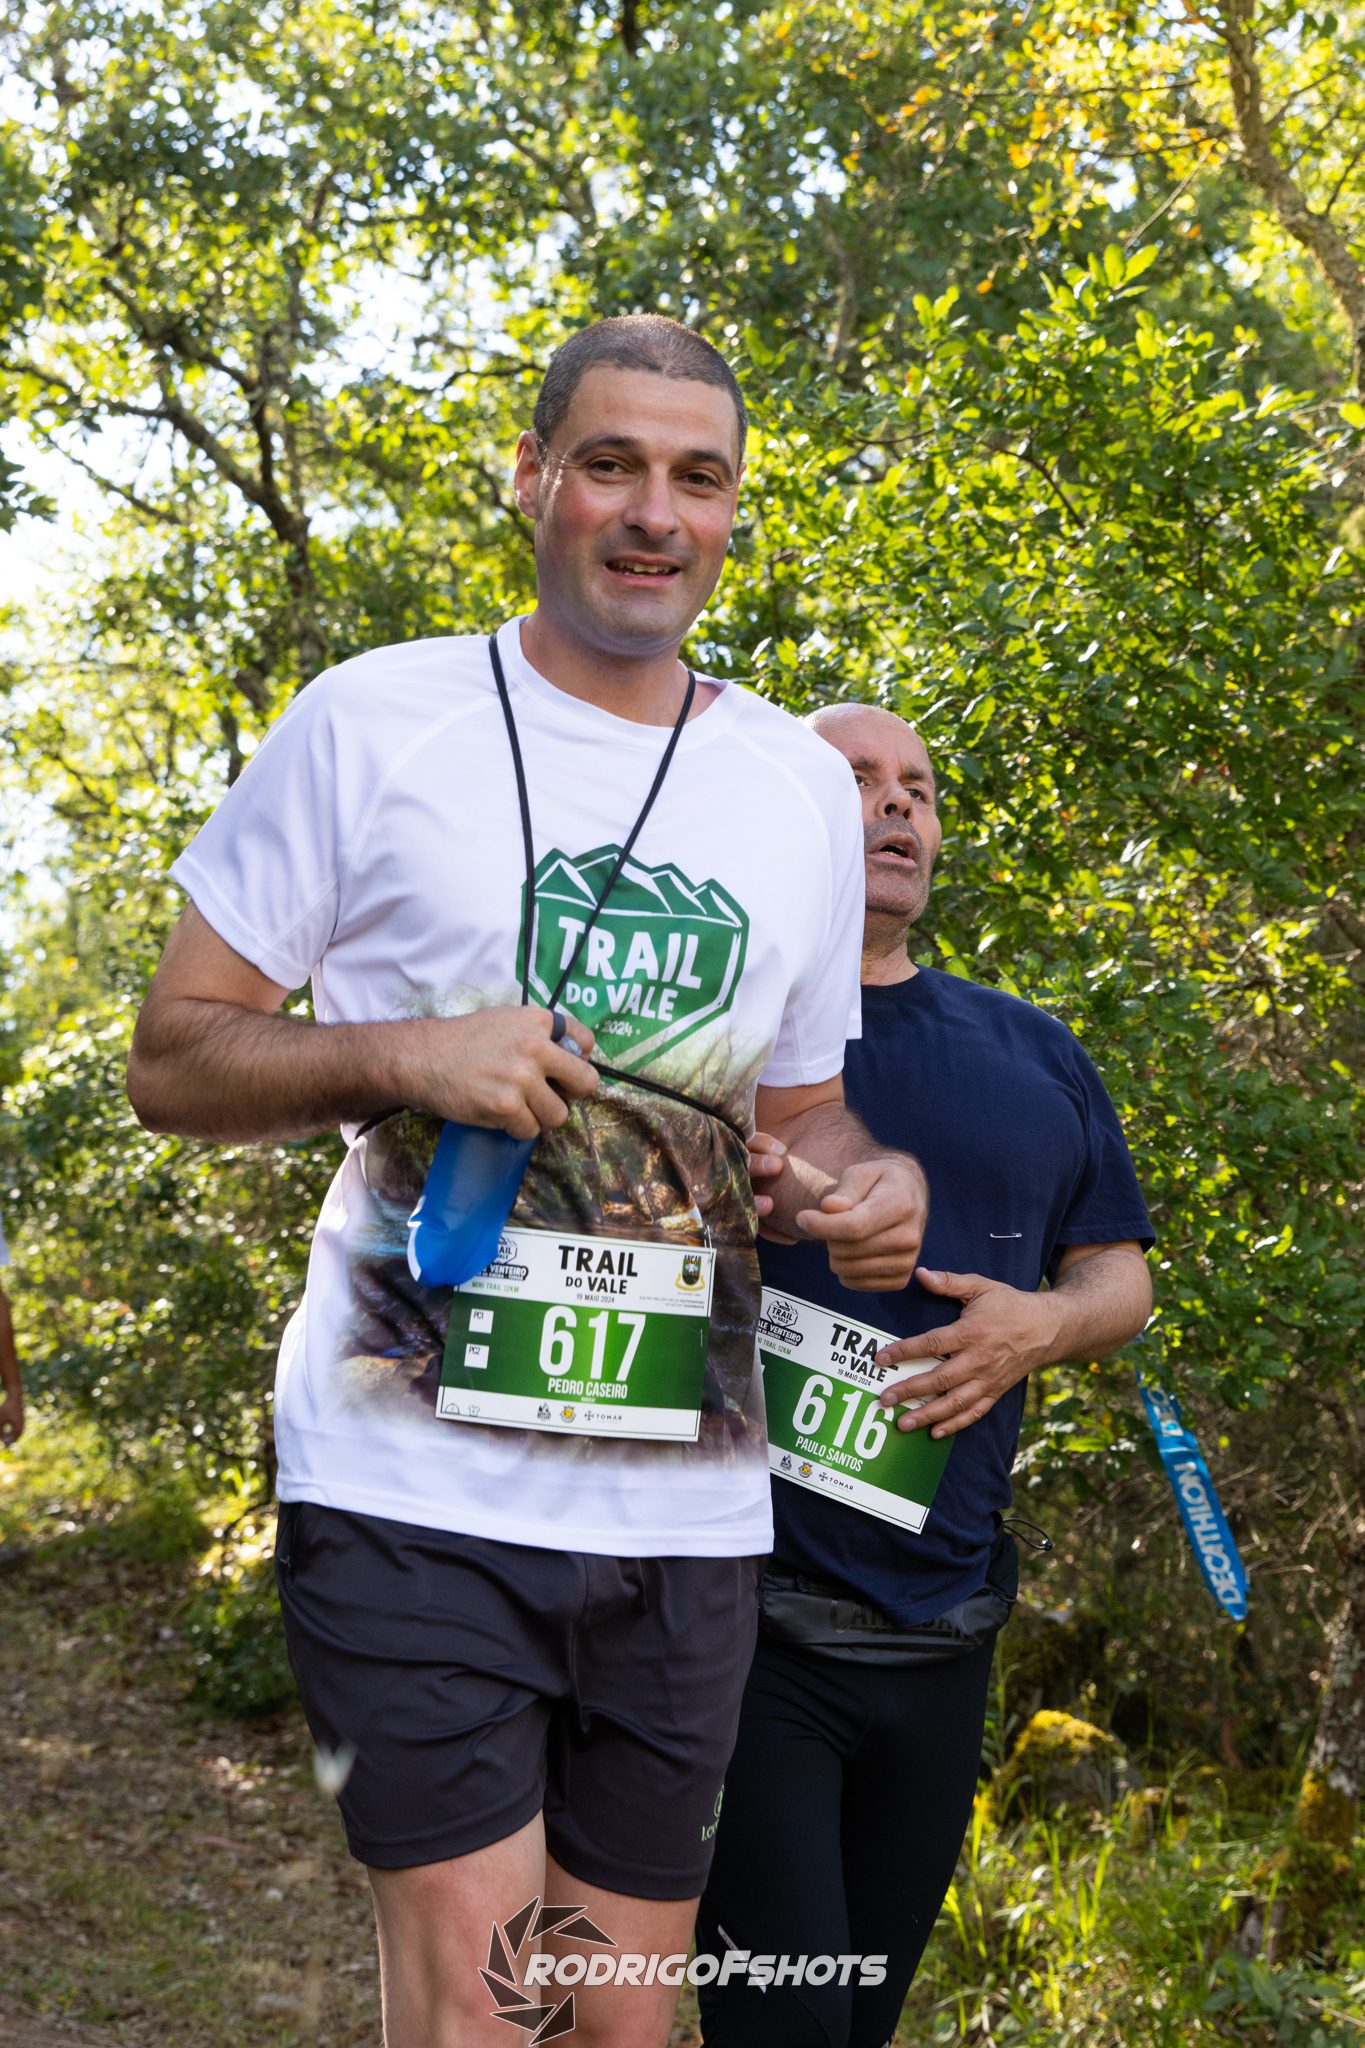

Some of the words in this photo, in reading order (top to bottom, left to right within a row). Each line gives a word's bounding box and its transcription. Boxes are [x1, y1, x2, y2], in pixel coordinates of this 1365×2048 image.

[558, 916, 703, 990] TRAIL
[565, 982, 597, 1008] DO
[606, 983, 679, 1022] VALE
[489, 1264, 527, 1276] VENTEIRO
[558, 1244, 638, 1278] TRAIL
[486, 1283, 501, 1291] TRAIL
[503, 1285, 520, 1294] 12KM
[565, 1276, 583, 1288] DO
[587, 1277, 628, 1295] VALE
[576, 1293, 583, 1302] 19
[584, 1294, 600, 1303] MAIO
[601, 1295, 615, 1304] 2024
[473, 1311, 484, 1320] PC1
[772, 1307, 793, 1321] TRAIL
[770, 1324, 802, 1342] VENTEIRO
[468, 1346, 480, 1355] PC2
[539, 1305, 647, 1382] 617
[830, 1323, 899, 1371] TRA
[830, 1351, 846, 1365] DO
[850, 1356, 887, 1383] VALE
[837, 1368, 844, 1376] 19
[844, 1370, 858, 1381] MAIO
[858, 1376, 872, 1387] 2024
[547, 1377, 583, 1396] PEDRO
[585, 1381, 628, 1399] CASEIRO
[596, 1413, 623, 1421] TOMAR
[792, 1374, 895, 1461] 616
[795, 1435, 827, 1457] PAULO
[826, 1448, 863, 1472] SANTOS
[829, 1477, 854, 1491] TOMAR
[1173, 1461, 1242, 1605] DECATHLON
